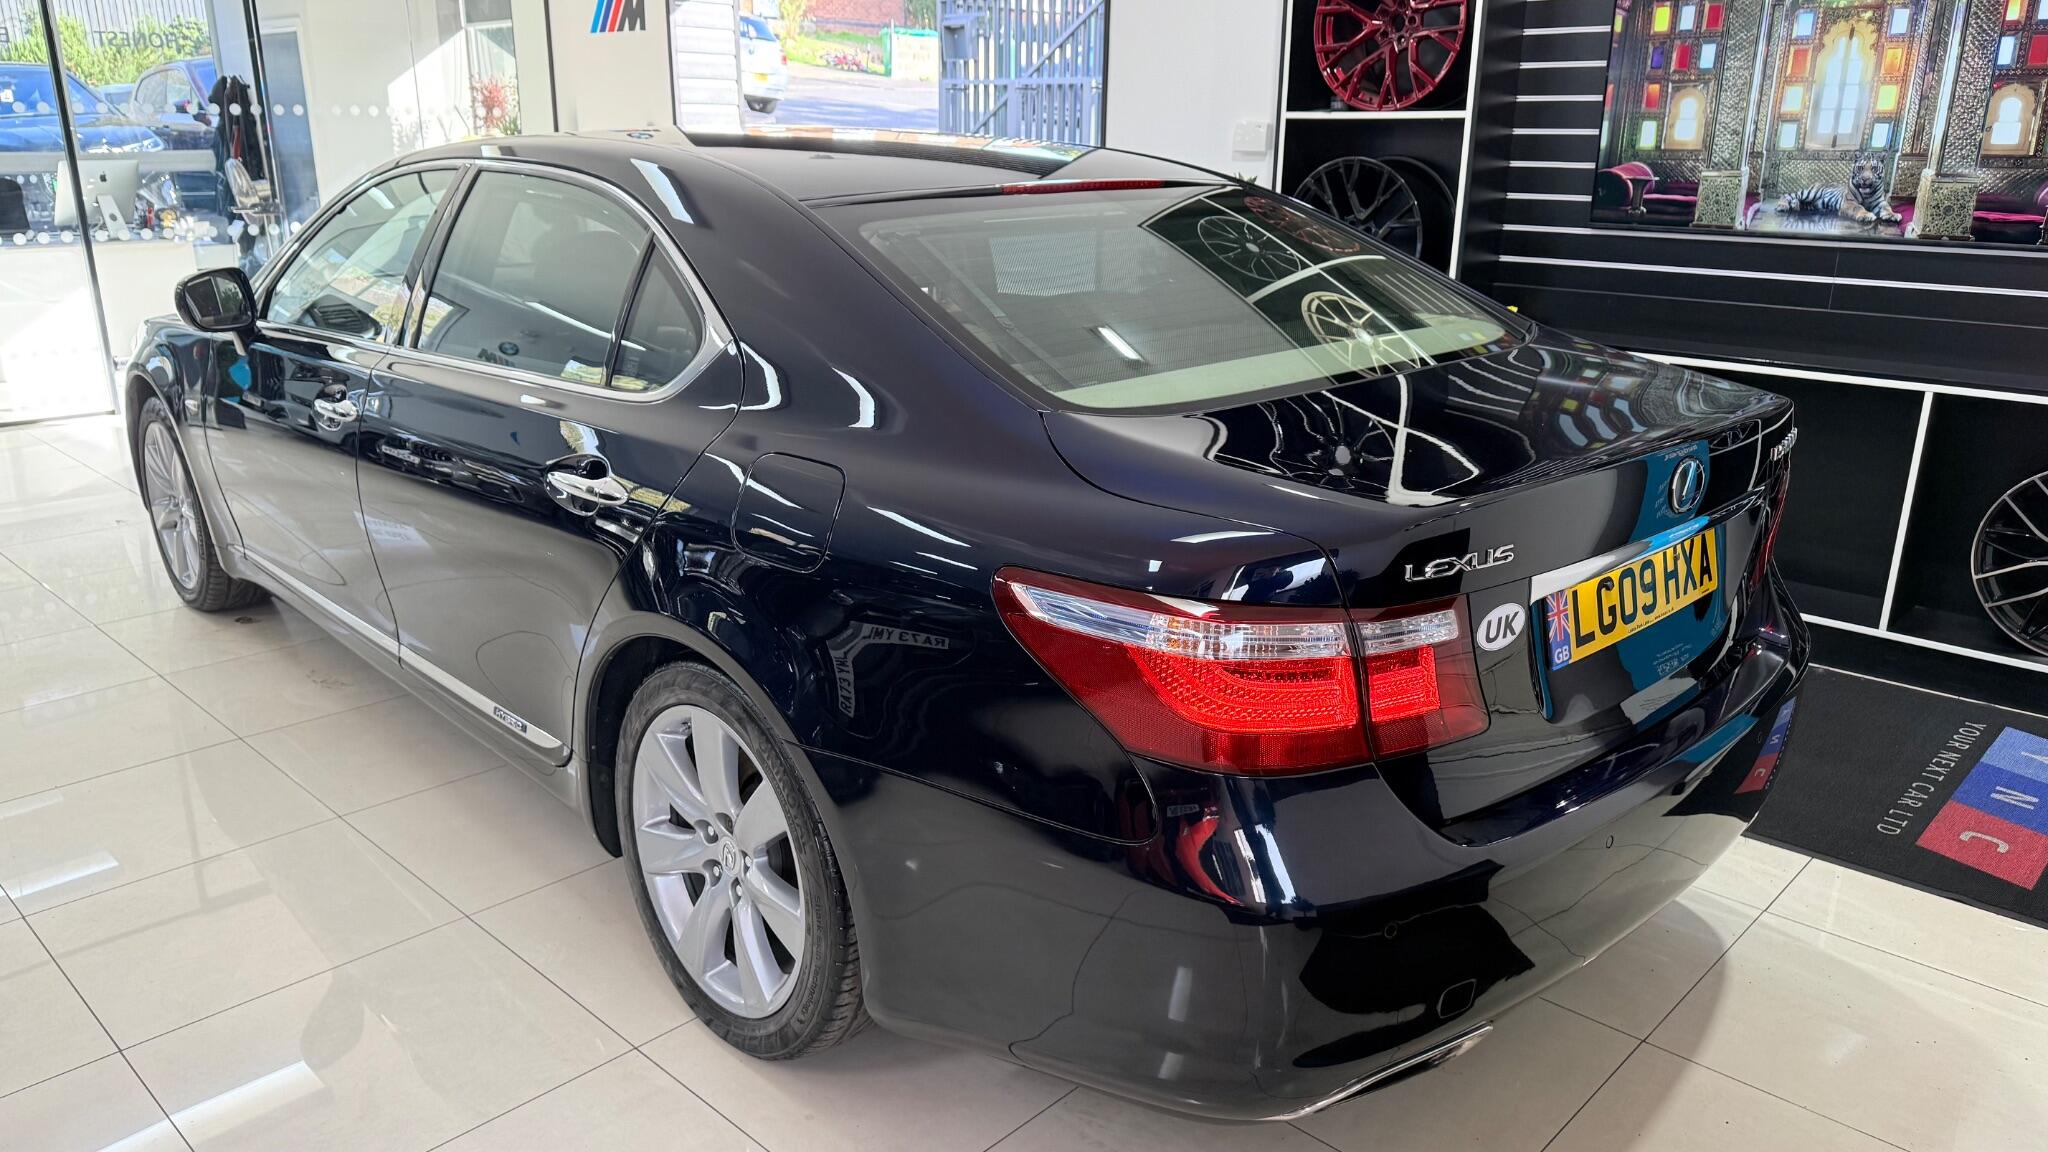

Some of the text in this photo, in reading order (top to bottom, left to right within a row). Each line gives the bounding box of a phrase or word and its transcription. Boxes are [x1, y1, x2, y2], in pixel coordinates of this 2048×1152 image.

[1404, 544, 1514, 581] LEXUS
[1572, 533, 1712, 648] LG09 HXA
[1485, 610, 1520, 644] UK
[1554, 645, 1570, 664] GB
[1876, 721, 1987, 835] YOUR NEXT CAR LTD
